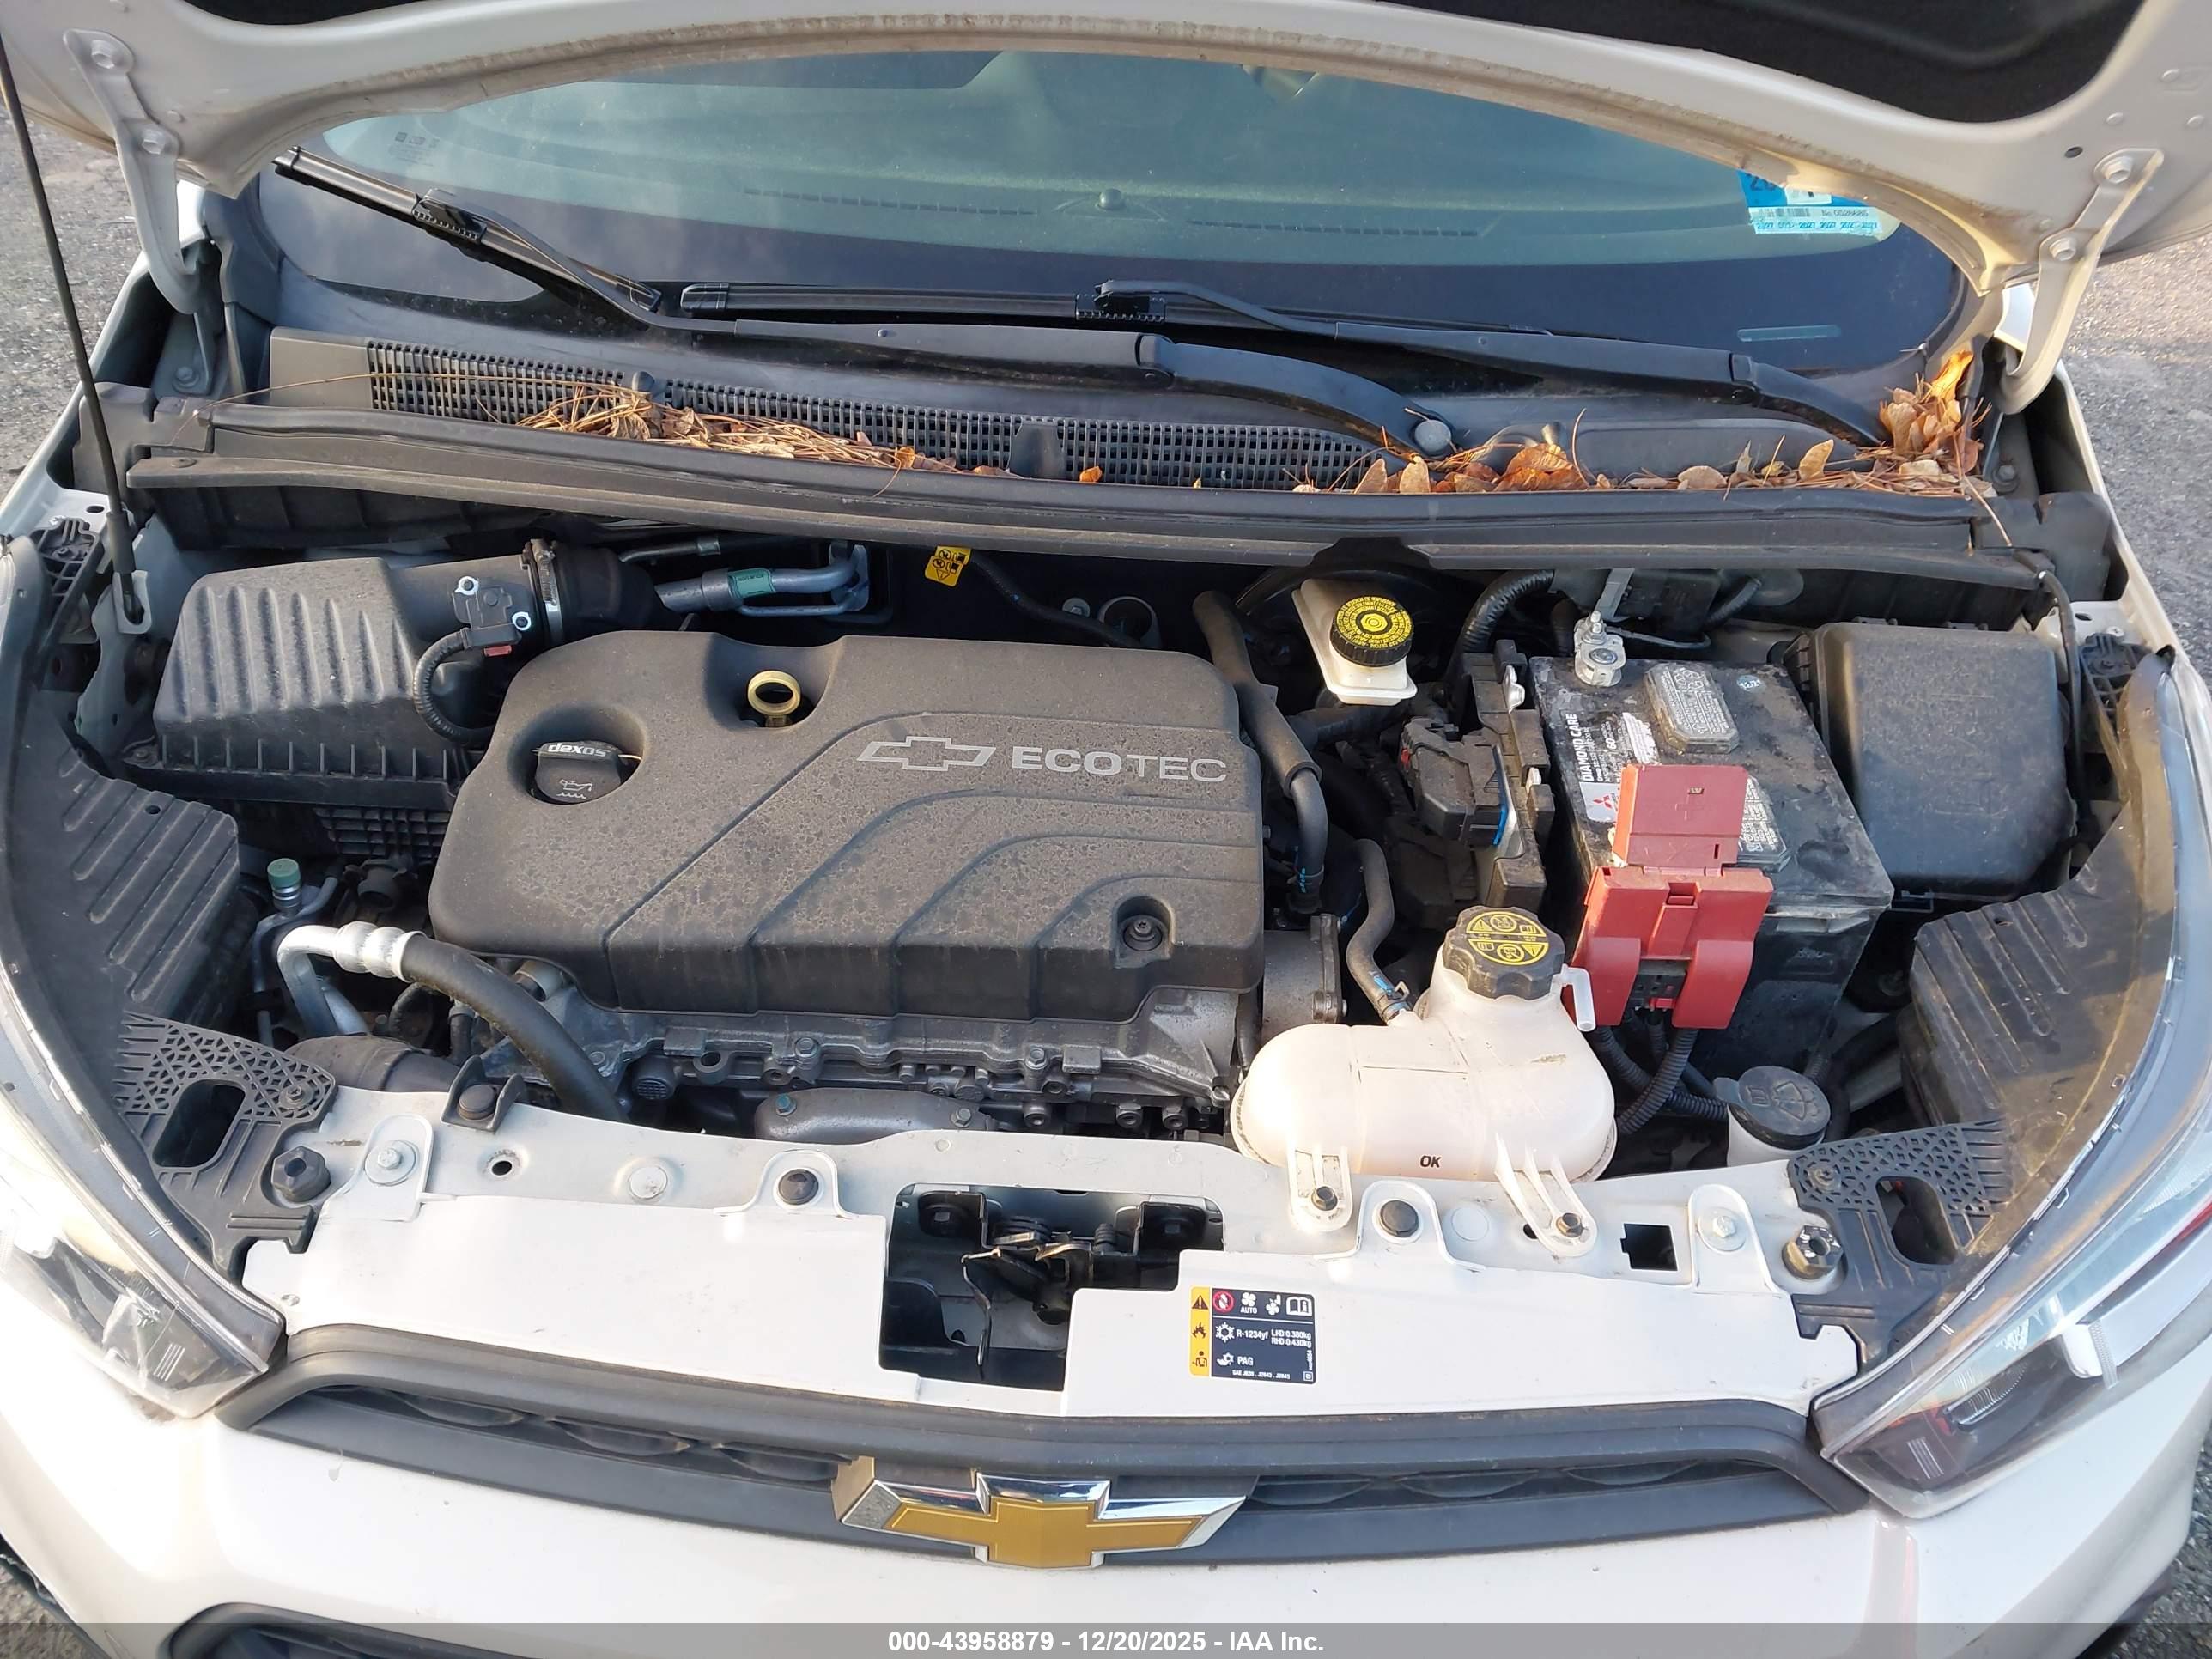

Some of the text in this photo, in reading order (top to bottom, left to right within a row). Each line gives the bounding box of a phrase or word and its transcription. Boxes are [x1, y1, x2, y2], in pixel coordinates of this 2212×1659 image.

[1566, 714, 1582, 737] CARE
[547, 743, 606, 757] dexos
[1605, 738, 1617, 750] 60
[1012, 746, 1227, 782] ECOTEC
[1573, 738, 1595, 781] DIAMOND
[1419, 1155, 1442, 1168] OK
[1237, 1328, 1269, 1341] R-1234yf
[1237, 1356, 1254, 1366] PAG
